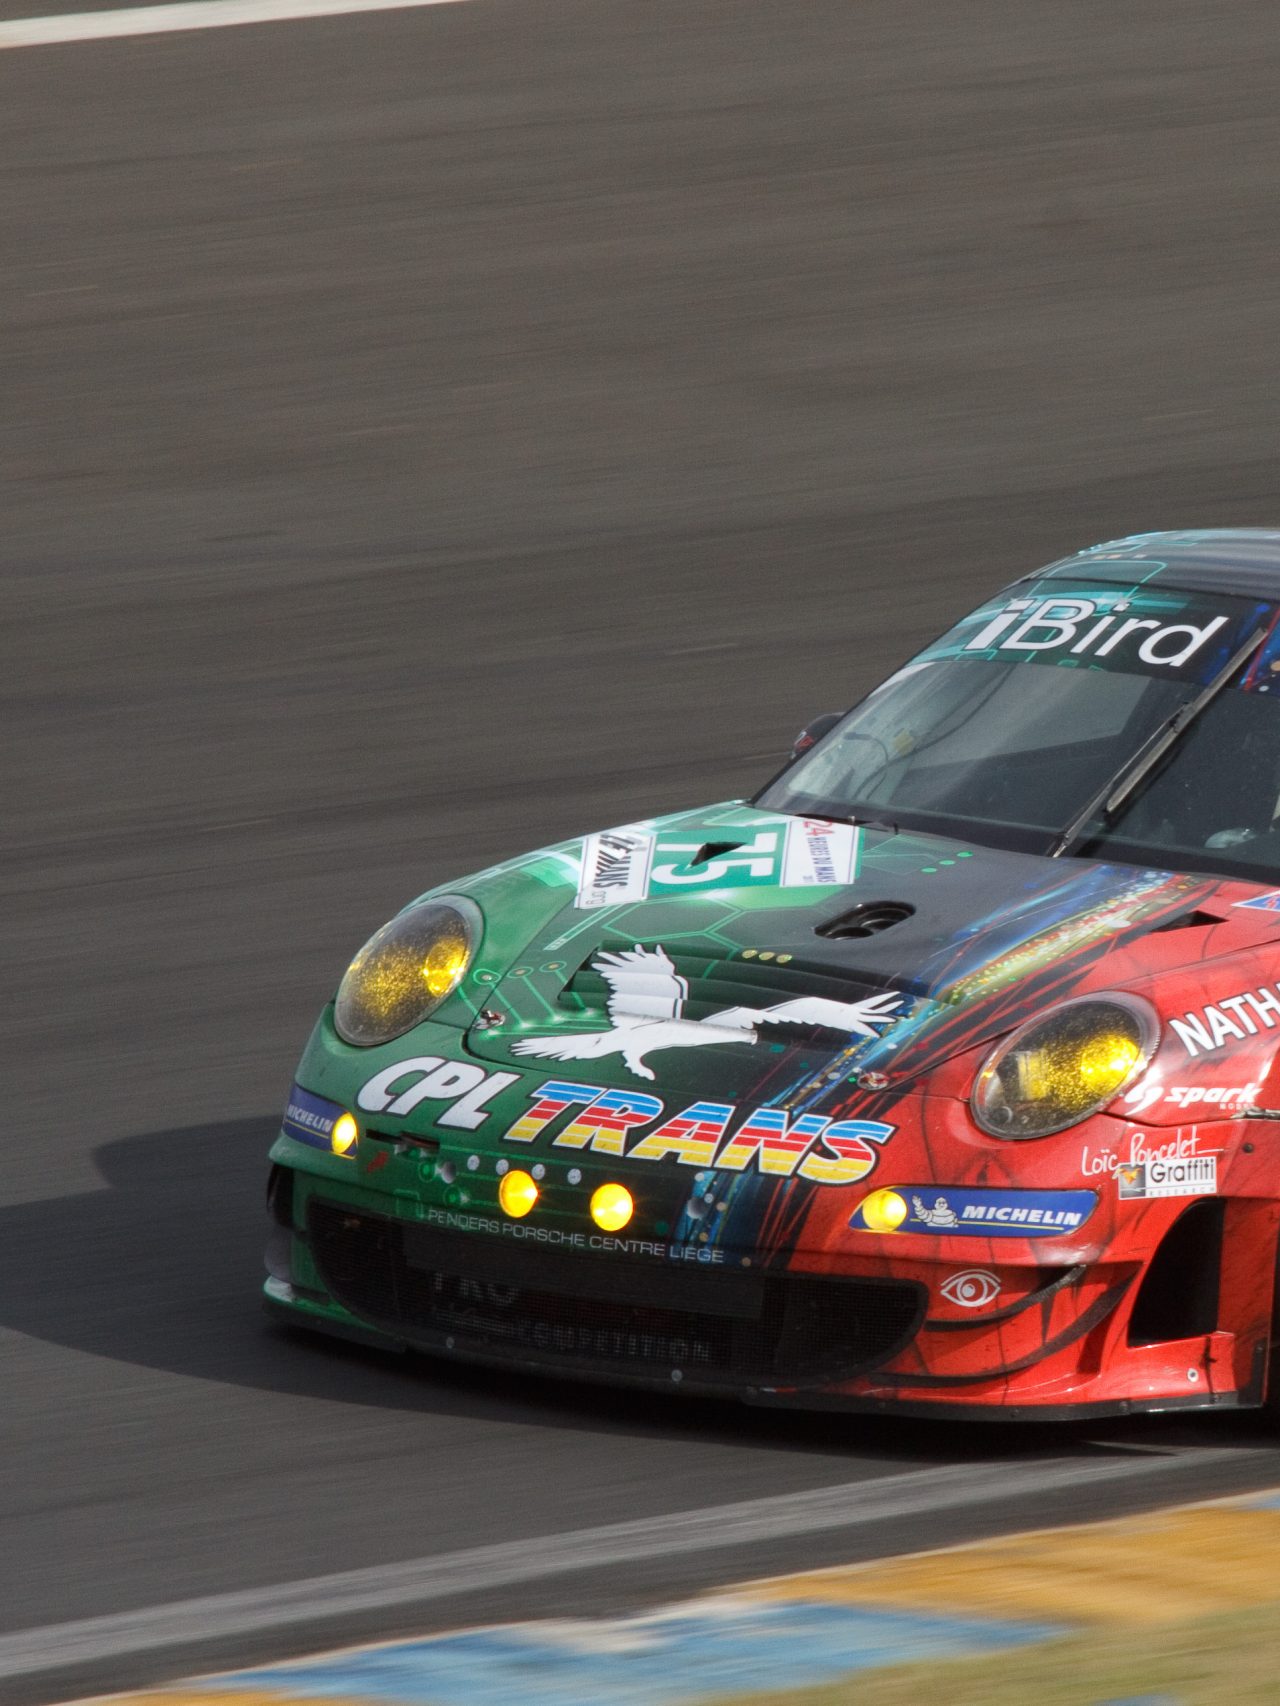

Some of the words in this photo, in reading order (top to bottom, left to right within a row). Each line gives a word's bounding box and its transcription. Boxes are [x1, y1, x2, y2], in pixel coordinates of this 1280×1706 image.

[964, 598, 1229, 667] iBird
[651, 832, 778, 884] 75
[358, 1056, 521, 1131] CPL
[1164, 1082, 1264, 1108] spark
[503, 1080, 895, 1184] TRANS
[1150, 1159, 1215, 1183] Graffiti
[428, 1209, 499, 1233] PENDERS
[502, 1223, 585, 1247] PORSCHE
[589, 1236, 666, 1257] CENTRE
[962, 1205, 1082, 1225] MICHELIN
